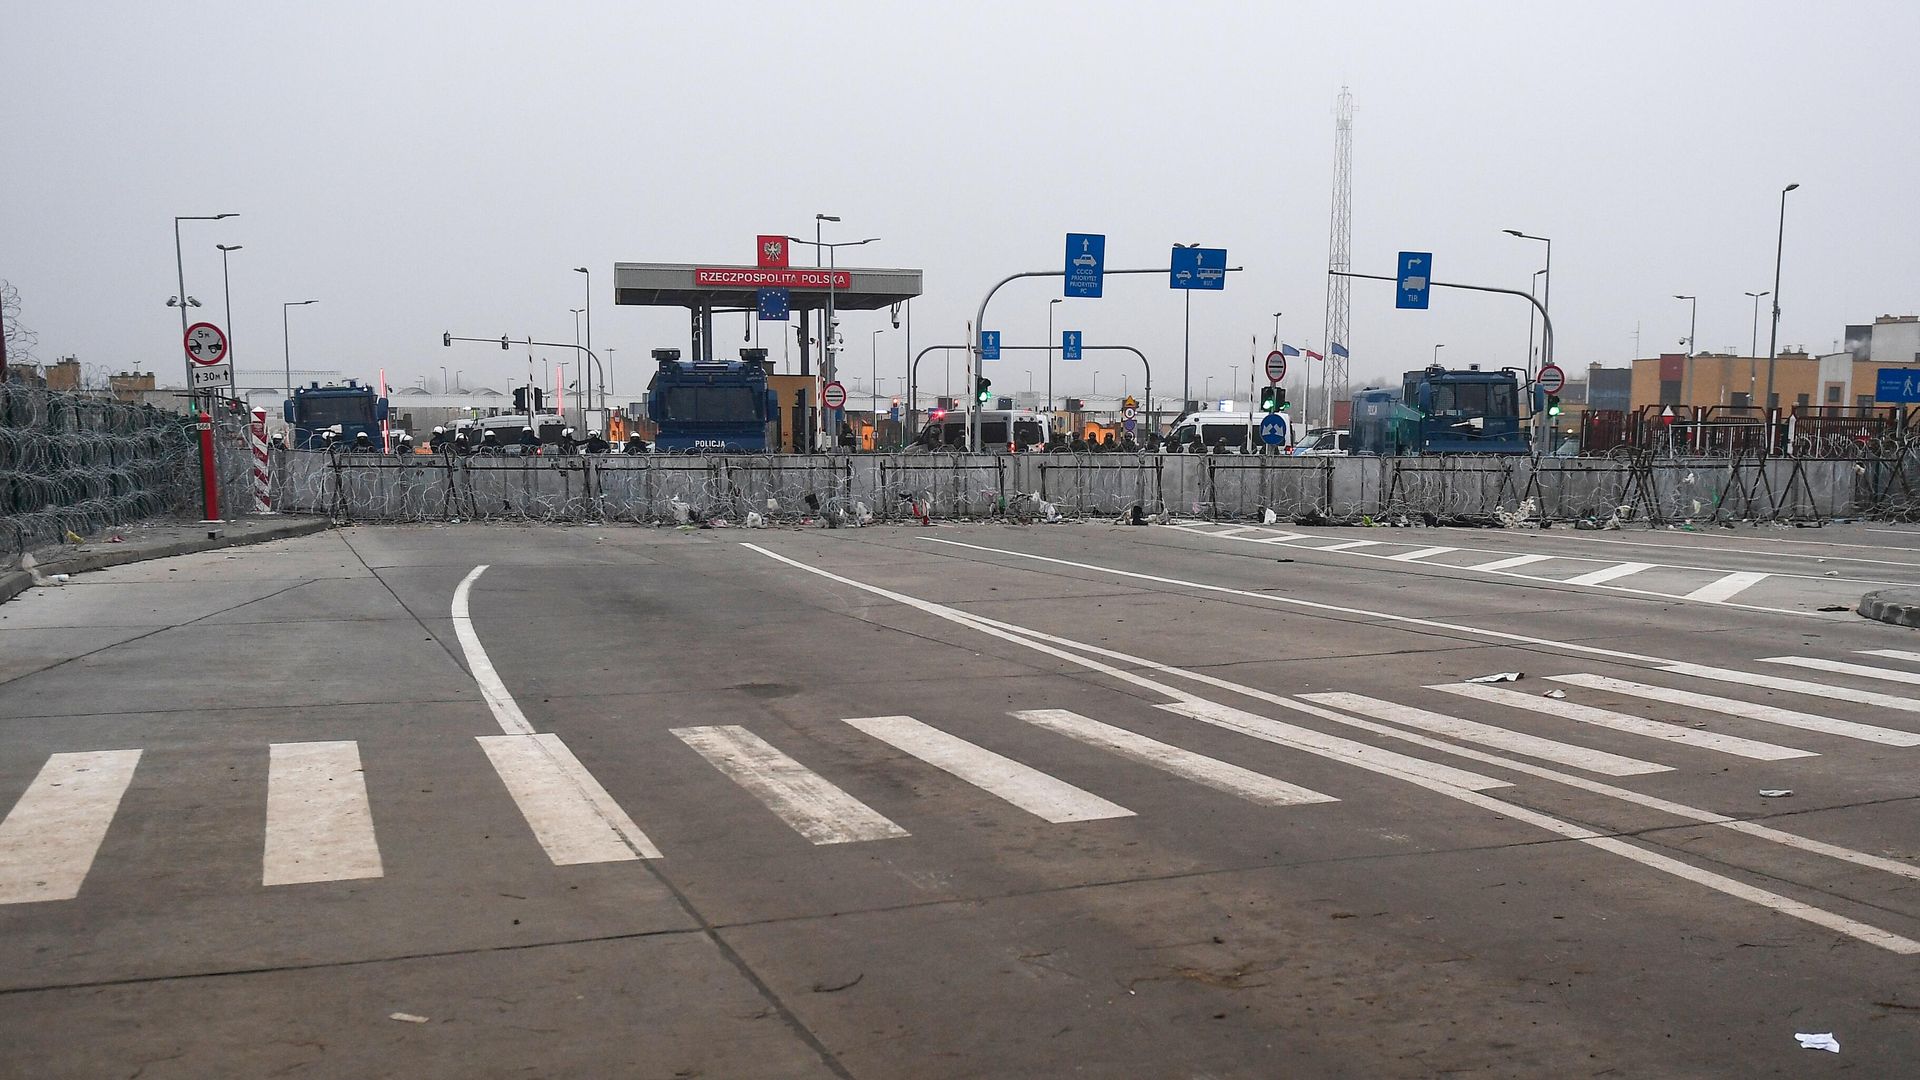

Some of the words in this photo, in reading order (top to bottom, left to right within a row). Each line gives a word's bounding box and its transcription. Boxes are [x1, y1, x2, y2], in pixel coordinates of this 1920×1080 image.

[700, 272, 797, 283] RZECZPOSPOLITA
[802, 273, 845, 284] POLSKA
[1407, 294, 1418, 302] TIR
